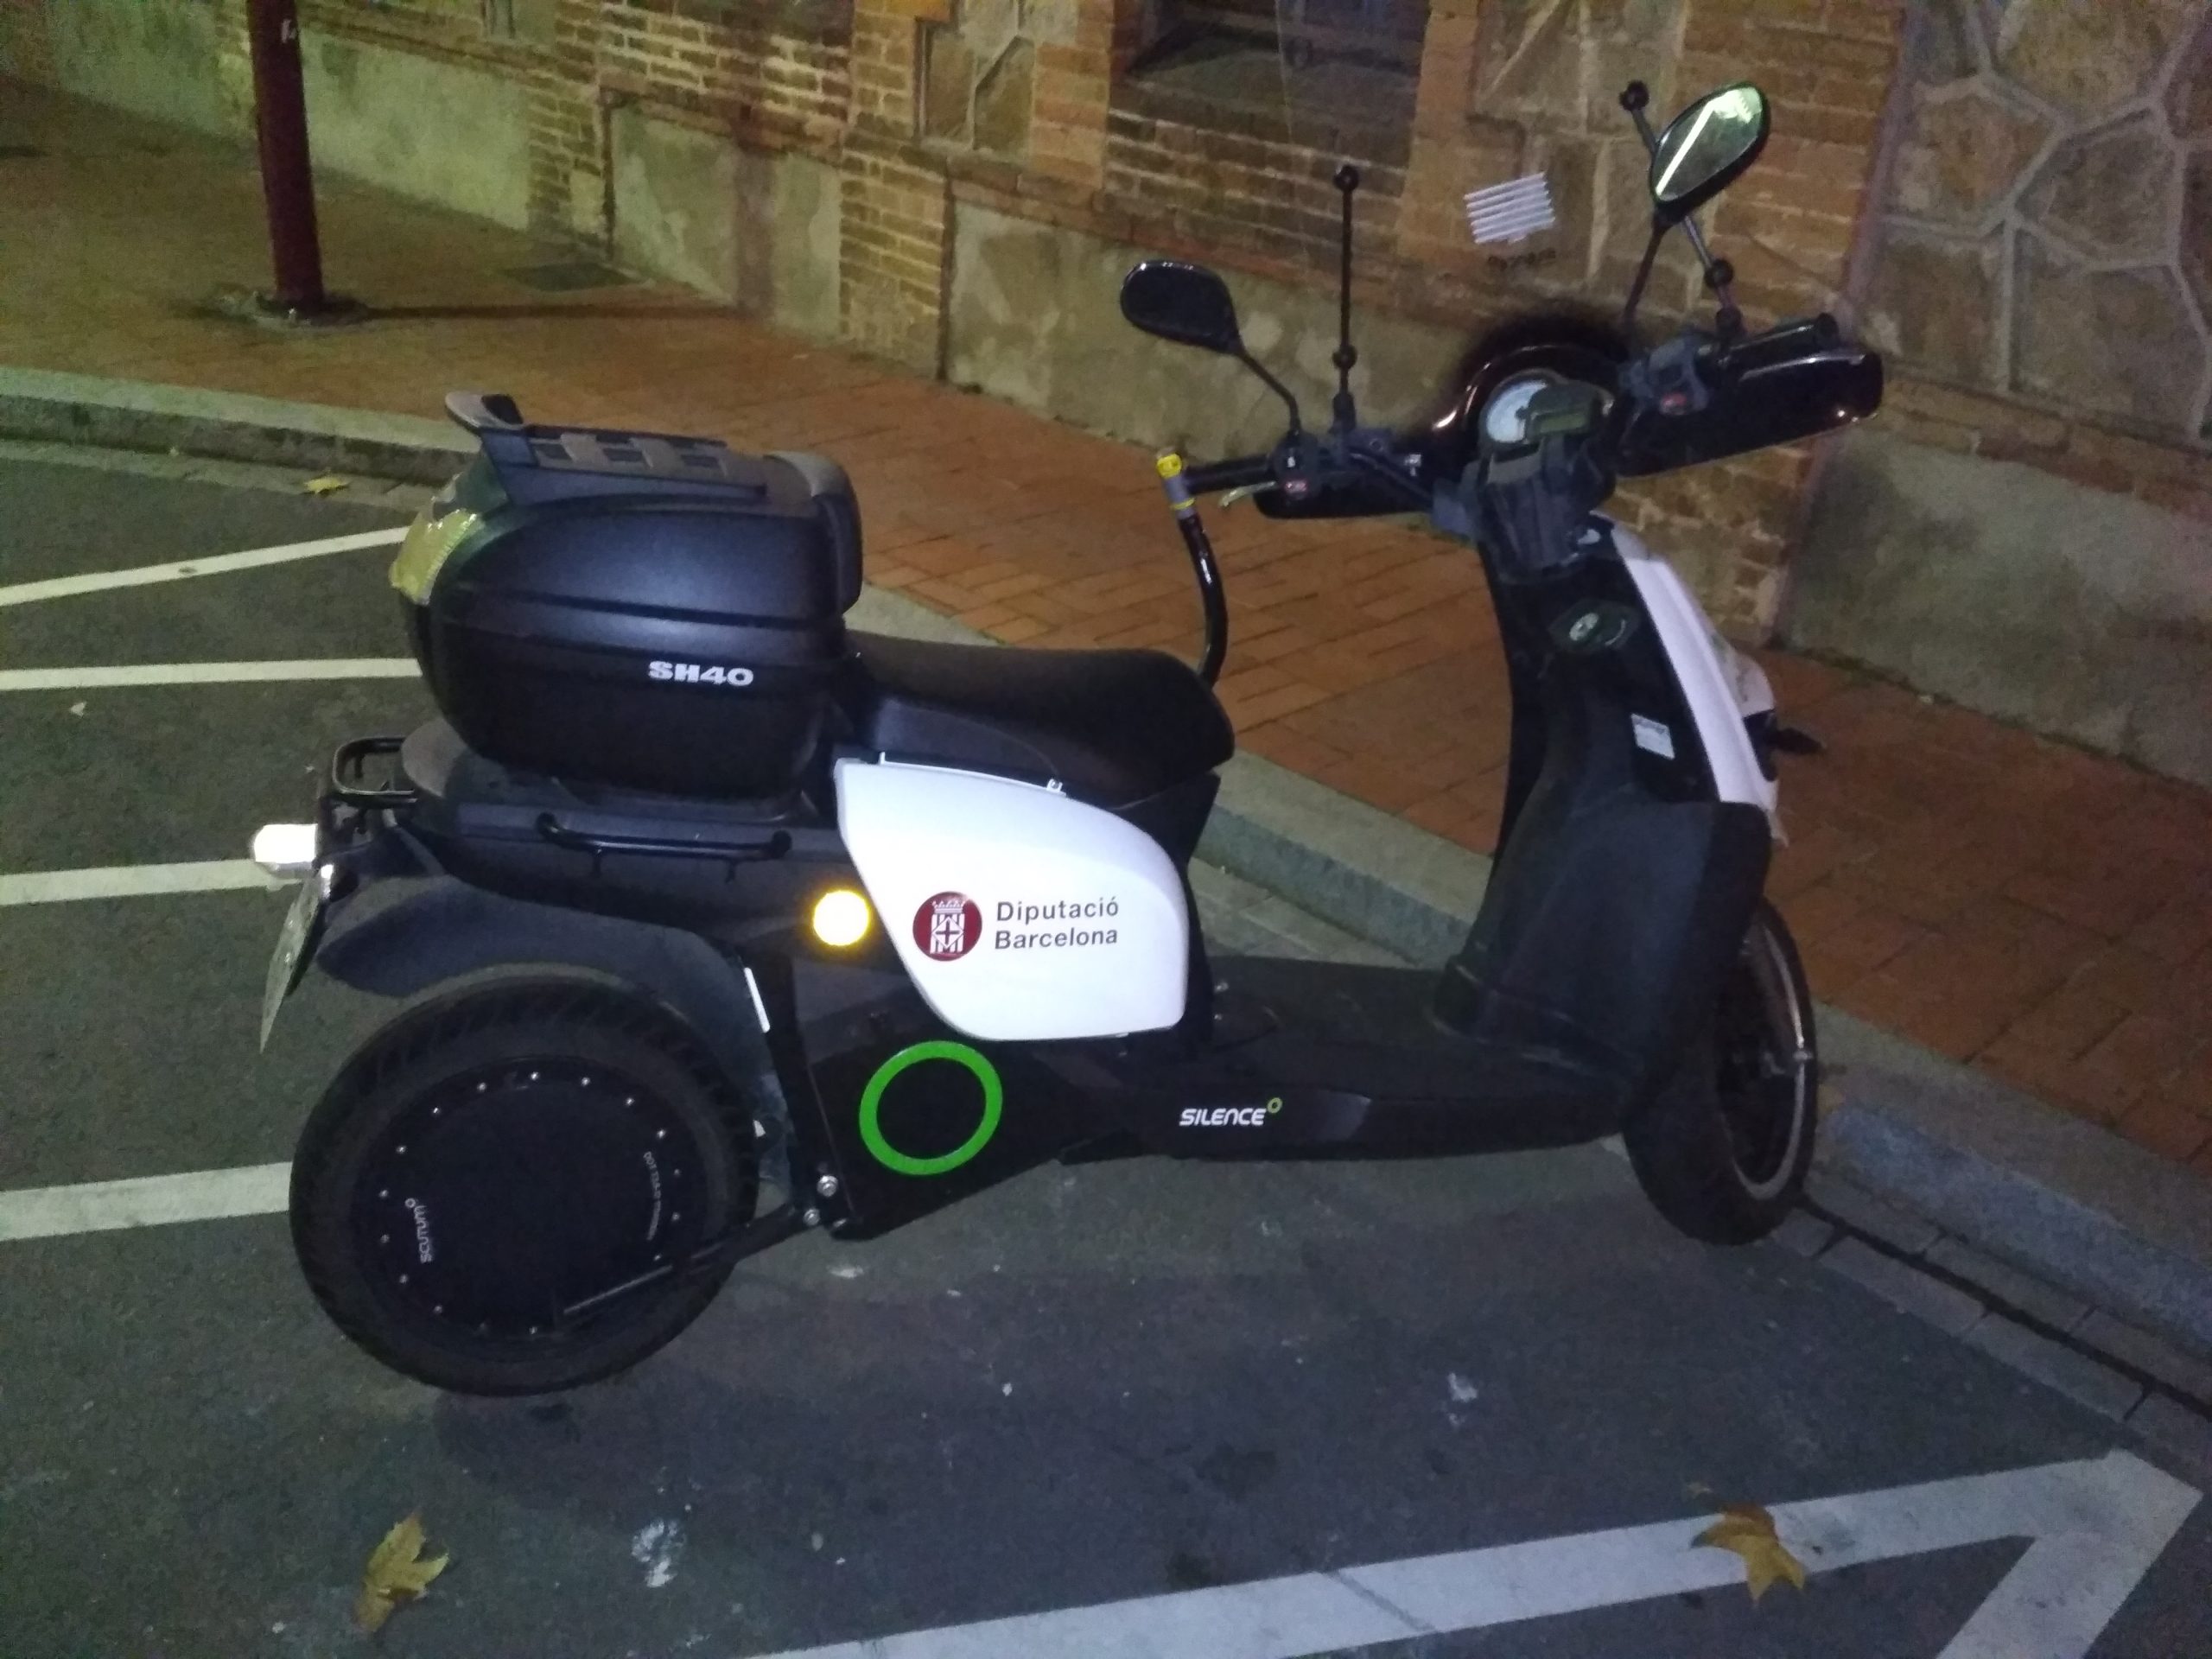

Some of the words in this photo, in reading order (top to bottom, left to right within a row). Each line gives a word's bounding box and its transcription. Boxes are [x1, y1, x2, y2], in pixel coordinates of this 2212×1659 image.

[648, 660, 754, 686] SH40
[996, 896, 1119, 925] Diputació
[995, 927, 1118, 950] Barcelona
[1179, 1107, 1267, 1126] SILENCE
